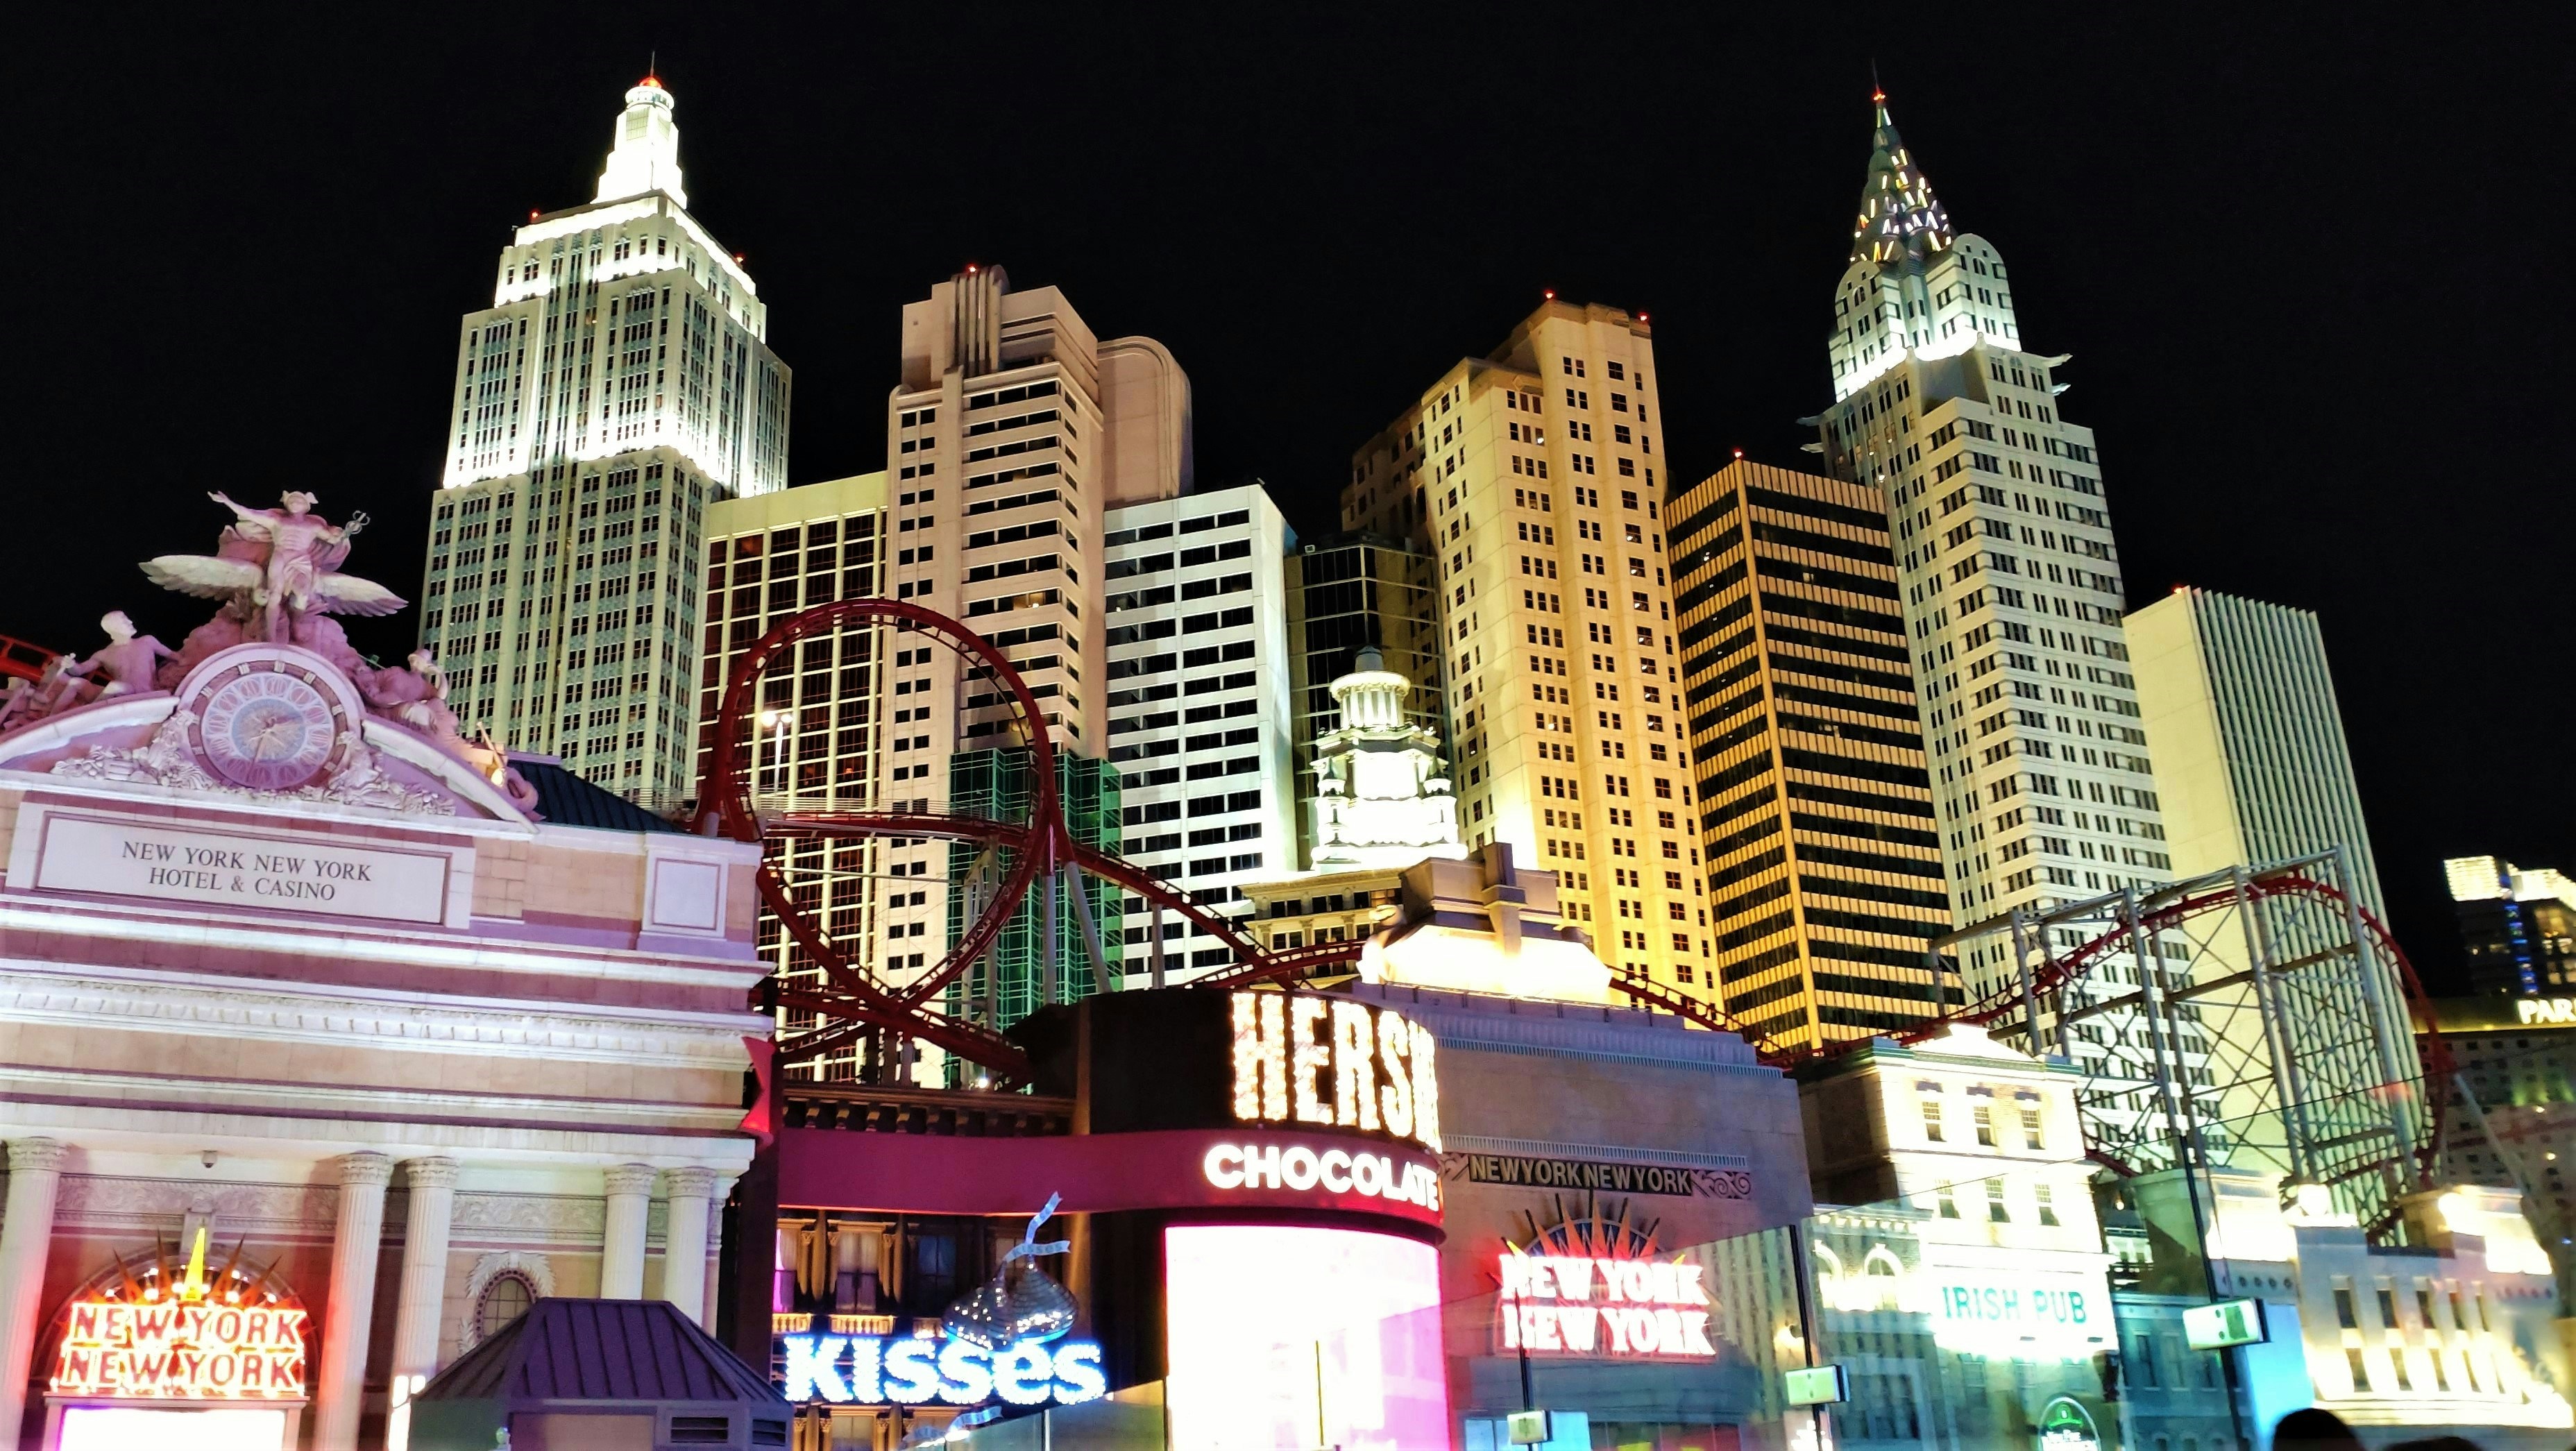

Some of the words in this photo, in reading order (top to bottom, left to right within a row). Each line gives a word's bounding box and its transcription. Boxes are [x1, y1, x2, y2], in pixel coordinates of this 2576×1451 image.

[122, 841, 176, 862] NEW
[185, 847, 244, 869] YORK
[254, 854, 305, 874] NEW
[314, 860, 371, 881] YORK
[149, 867, 222, 890] HOTEL
[231, 875, 244, 892] &
[255, 878, 335, 901] CASINO
[1204, 1144, 1439, 1212] CHOCOLATE
[1582, 1162, 1631, 1189] NEW
[1633, 1167, 1692, 1193] YORK
[1499, 1254, 1595, 1300] NEW
[1595, 1259, 1709, 1305] YORK
[72, 1305, 173, 1342] NEW
[183, 1307, 304, 1346] YORK
[1942, 1287, 2021, 1320] IRISH
[2031, 1290, 2087, 1323] PUB
[1502, 1305, 1598, 1350] NEW
[1598, 1307, 1715, 1355] YORK
[61, 1348, 171, 1386] NEW
[179, 1352, 303, 1389] YORK
